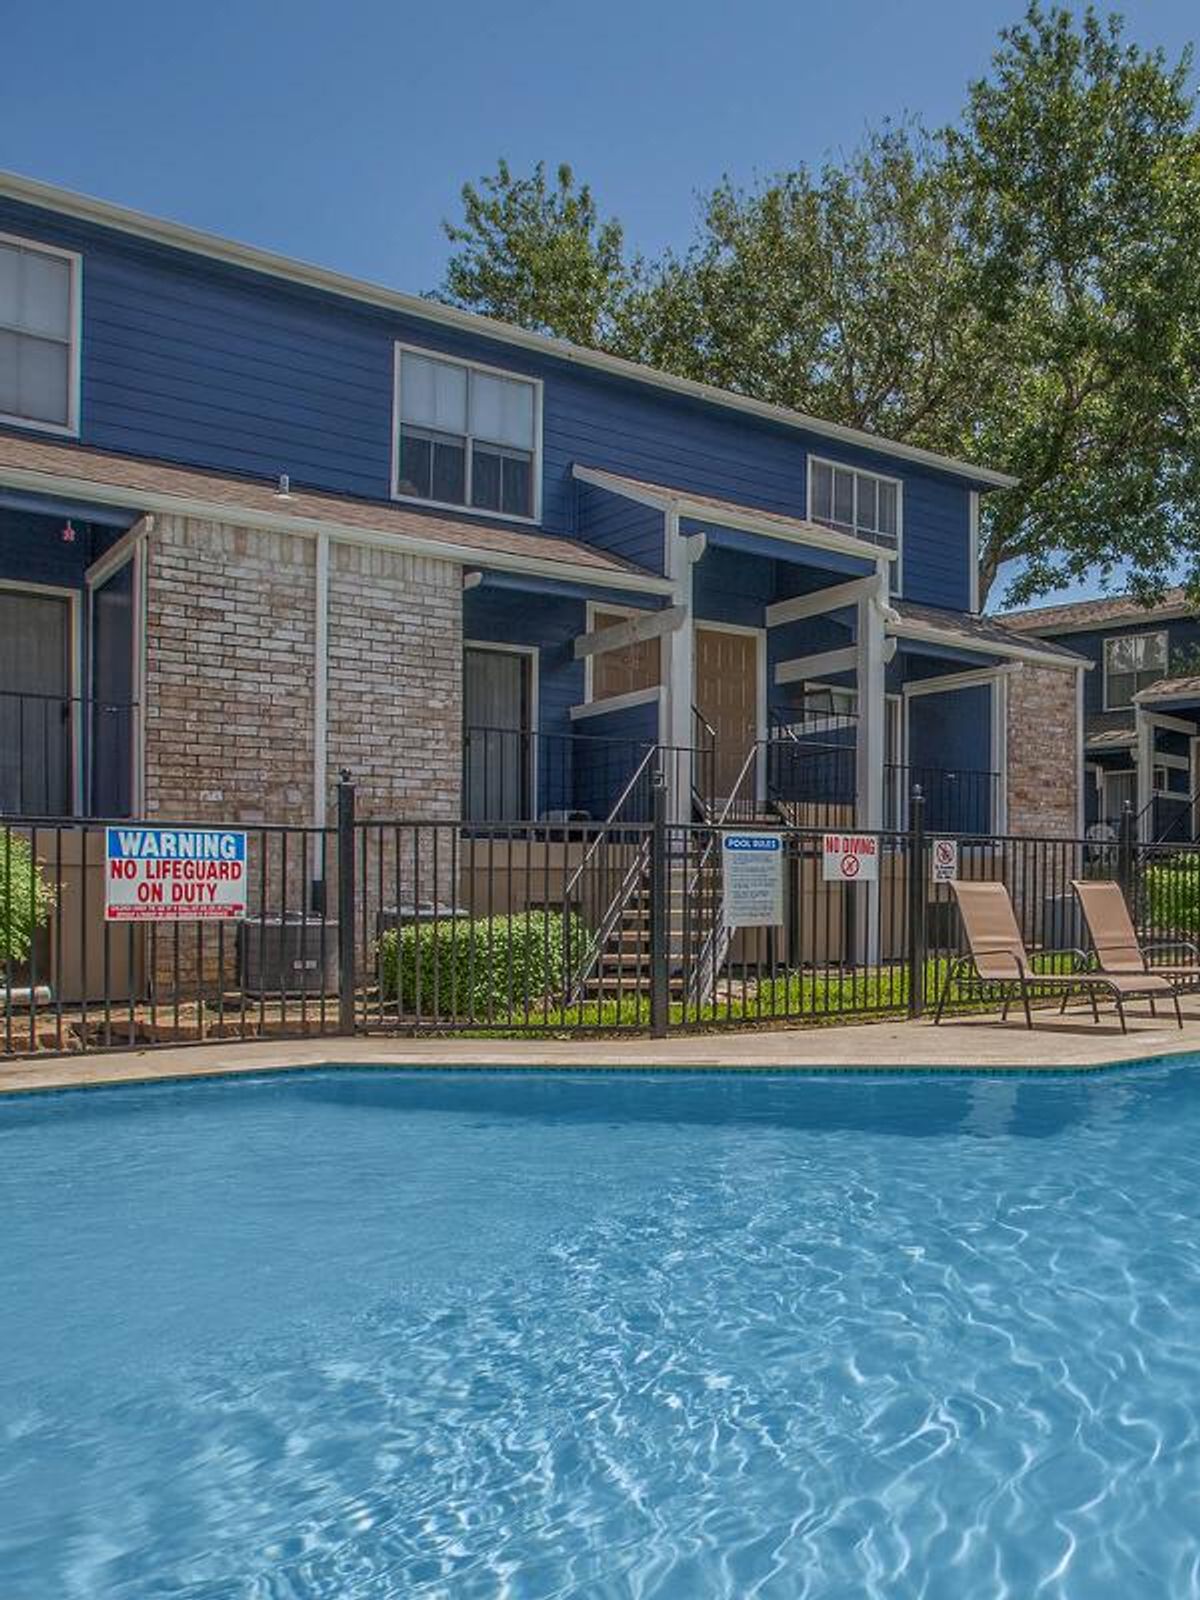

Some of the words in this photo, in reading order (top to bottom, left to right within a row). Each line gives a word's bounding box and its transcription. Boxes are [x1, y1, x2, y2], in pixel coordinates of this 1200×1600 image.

[118, 831, 236, 859] WARNING
[728, 839, 751, 848] POOL
[826, 837, 839, 853] NO
[843, 837, 875, 855] DIVING
[111, 860, 137, 879] NO
[146, 860, 242, 880] LIFEGUARD
[138, 882, 163, 902] ON
[172, 883, 217, 902] DUTY
